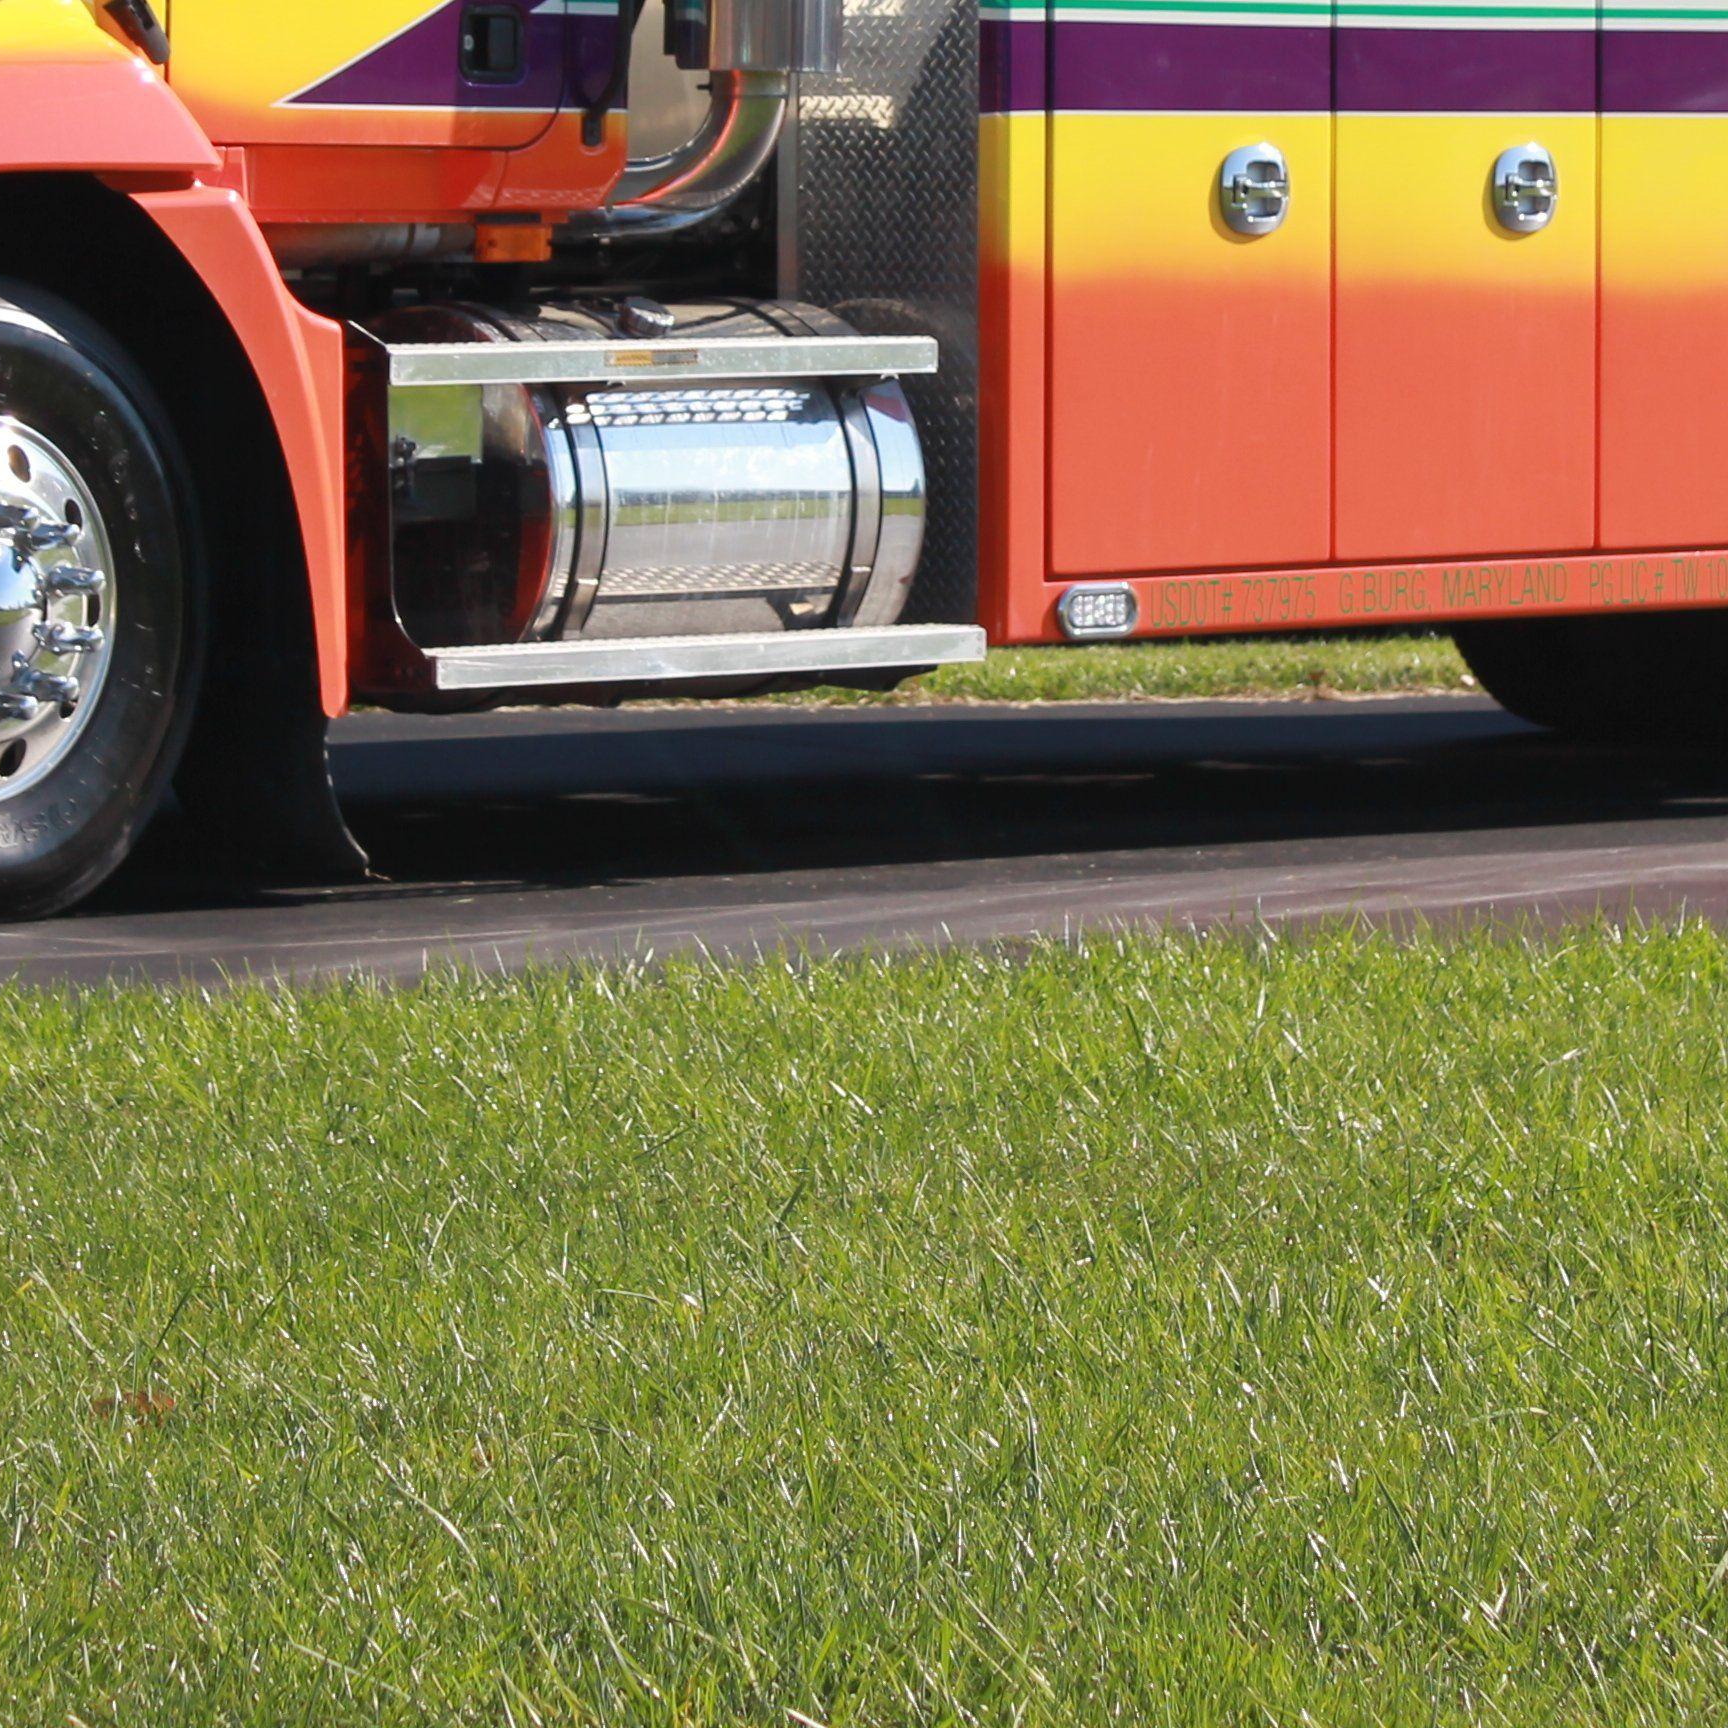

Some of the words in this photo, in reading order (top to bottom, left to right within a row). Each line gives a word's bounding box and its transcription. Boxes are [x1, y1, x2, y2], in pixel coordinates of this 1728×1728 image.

[1241, 575, 1316, 623] 737975
[1441, 563, 1568, 608] MARYLAND
[1671, 558, 1700, 602] TW
